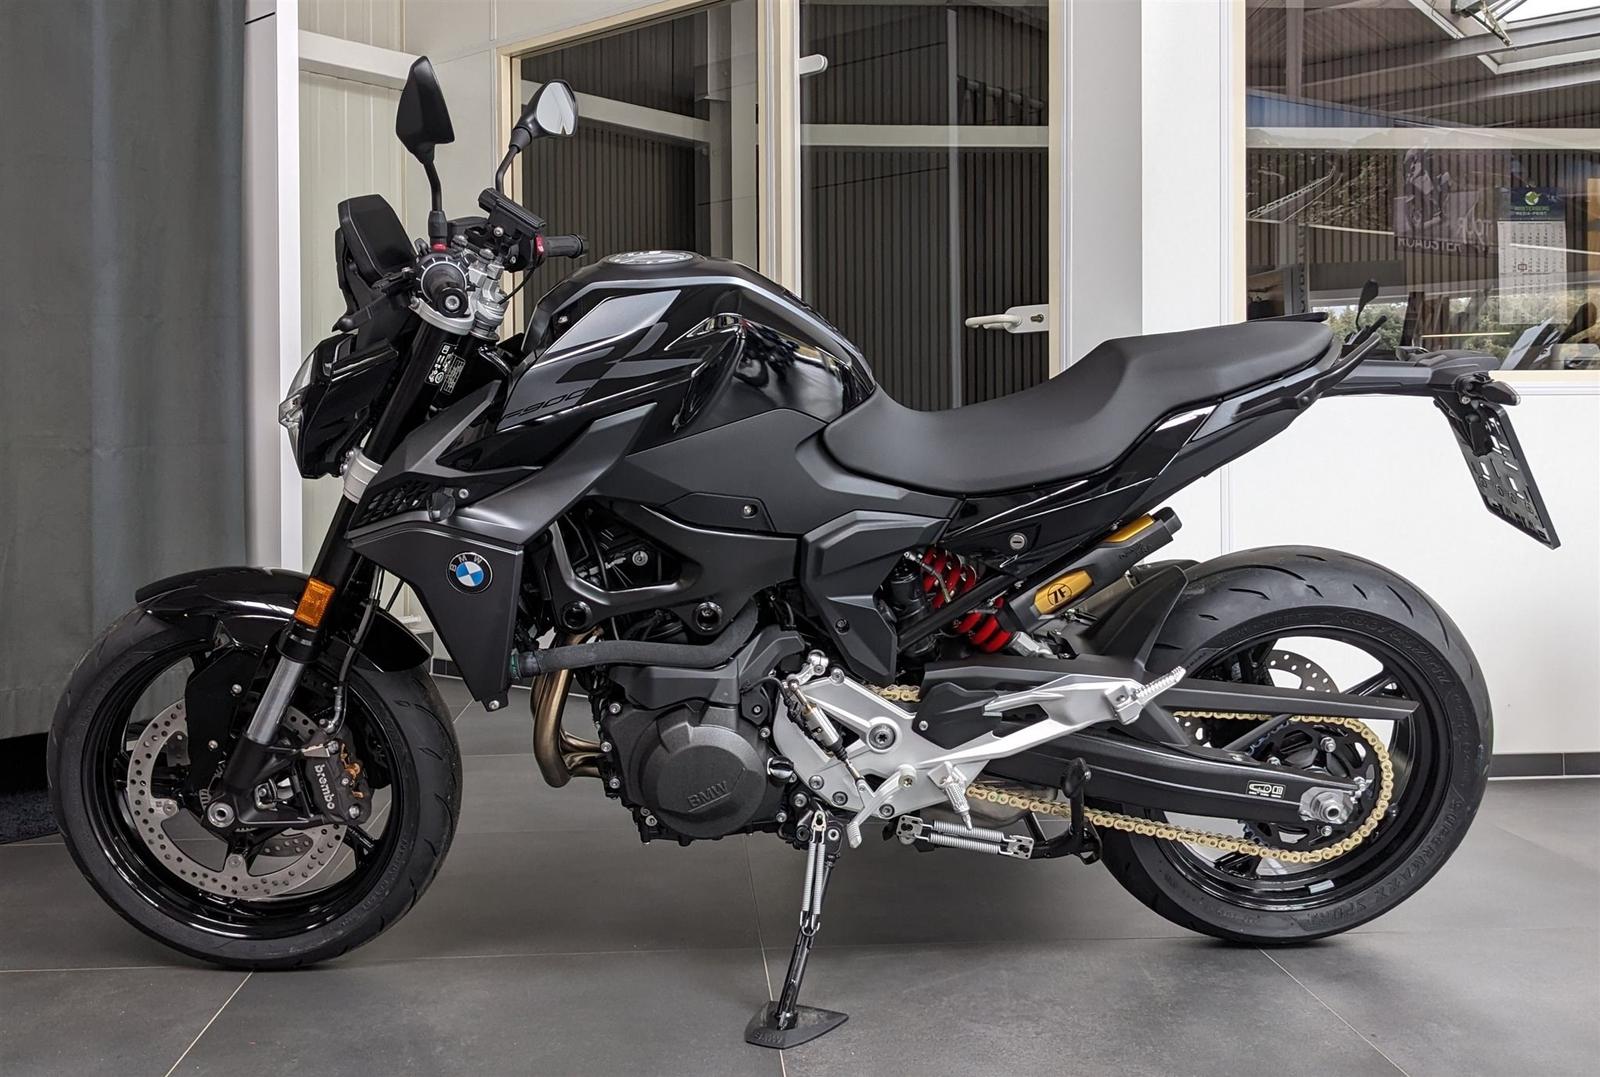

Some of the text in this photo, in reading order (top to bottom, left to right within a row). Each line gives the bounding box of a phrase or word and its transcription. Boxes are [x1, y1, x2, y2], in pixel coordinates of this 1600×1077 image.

[449, 554, 483, 572] BMW
[314, 764, 335, 809] brembo
[687, 780, 730, 808] BMW
